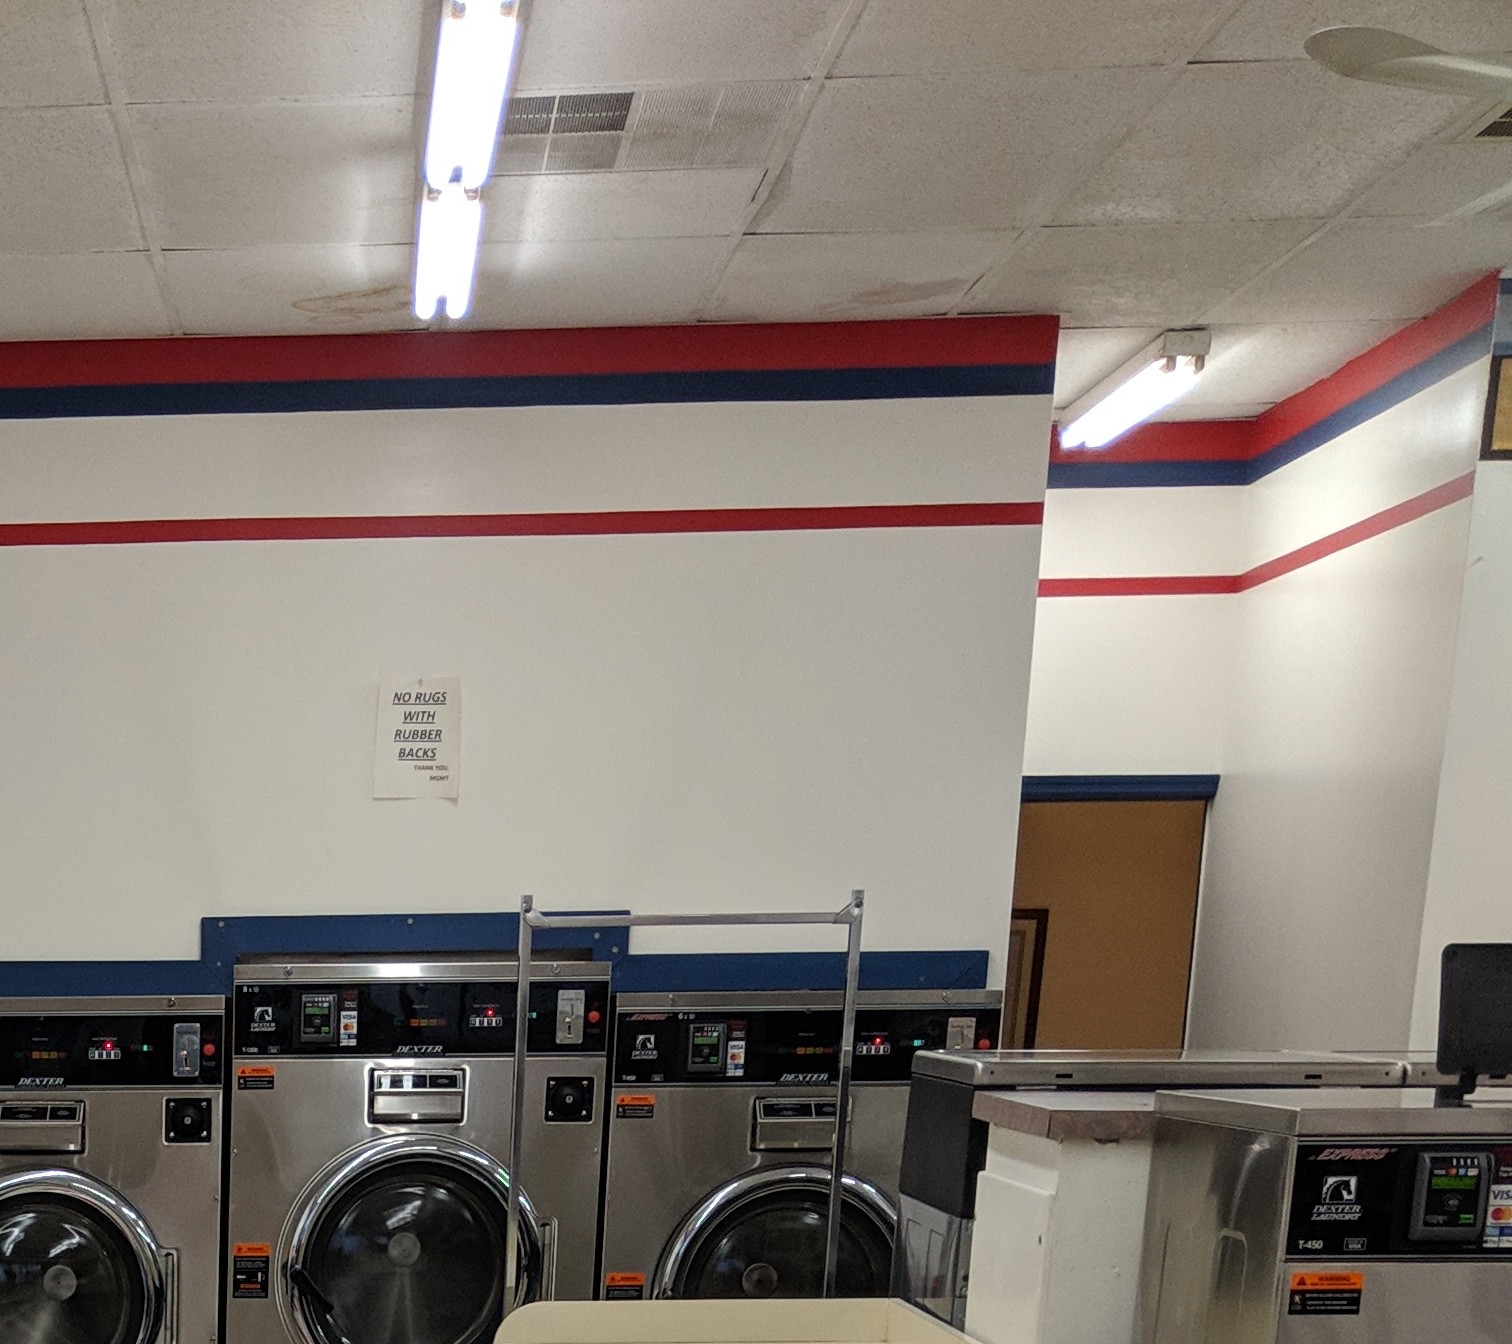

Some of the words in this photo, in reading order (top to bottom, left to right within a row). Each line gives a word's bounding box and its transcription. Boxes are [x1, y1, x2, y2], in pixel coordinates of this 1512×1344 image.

[393, 691, 412, 704] NO
[414, 691, 447, 704] RUGS
[402, 710, 436, 723] WITH
[394, 729, 443, 741] RUBBER
[398, 747, 437, 760] BACKS
[395, 1045, 444, 1054] DEXTER
[17, 1077, 65, 1086] DEXTER
[780, 1073, 829, 1082] DEXTER
[1317, 1148, 1390, 1161] EXPRESS
[1312, 1205, 1361, 1213] DEXTER
[1311, 1213, 1362, 1221] LAUNDRY
[1298, 1240, 1324, 1250] T-450
